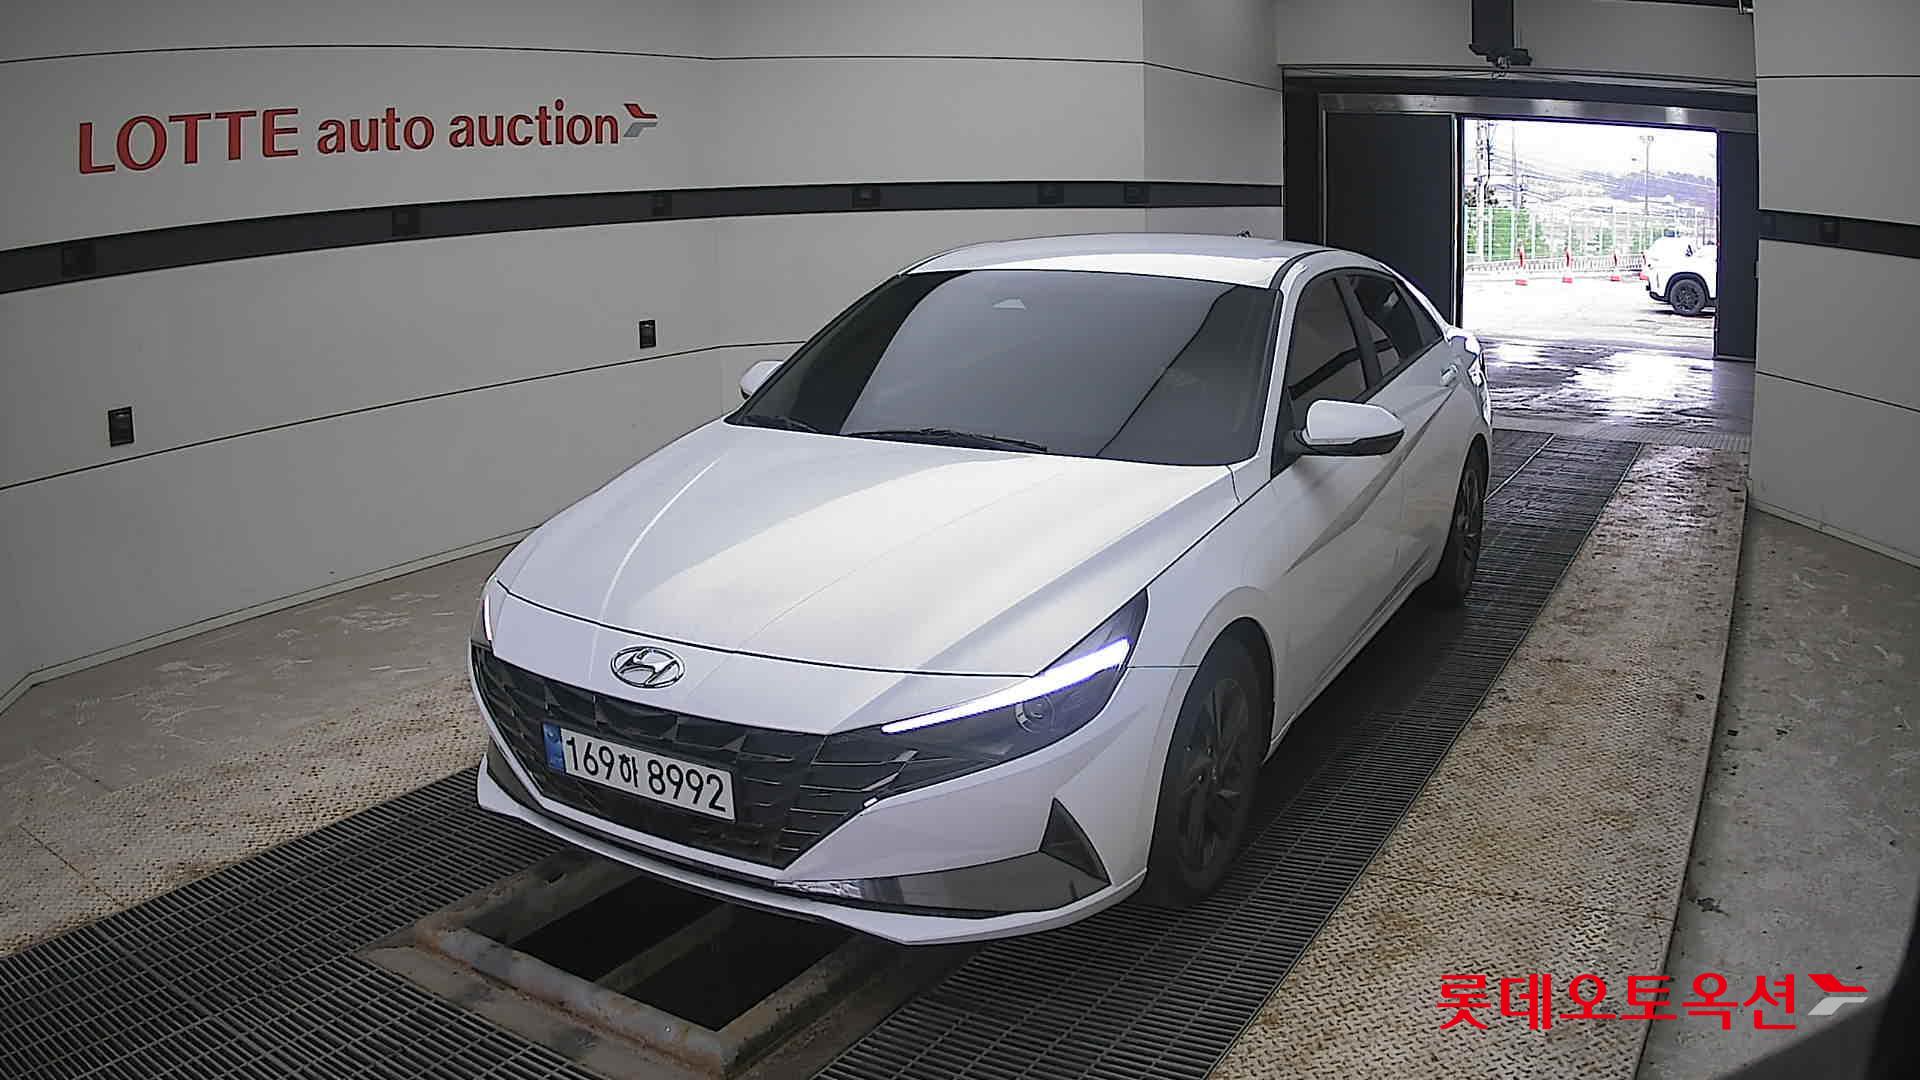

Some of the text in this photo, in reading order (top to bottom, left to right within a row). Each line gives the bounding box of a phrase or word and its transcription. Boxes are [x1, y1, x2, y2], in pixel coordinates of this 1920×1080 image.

[78, 98, 620, 175] LOTTE auto auction
[565, 736, 727, 813] 169하 8992
